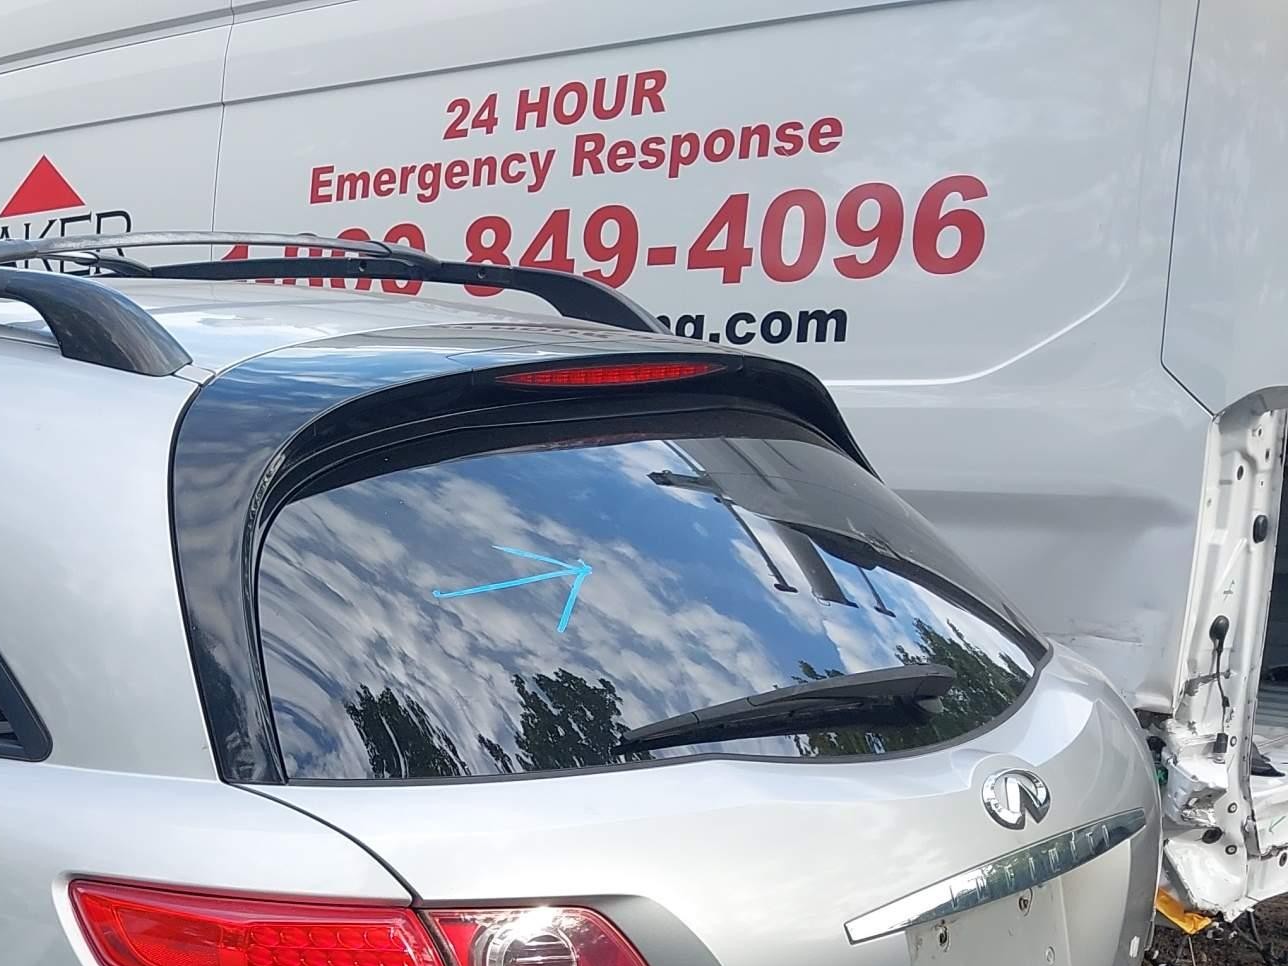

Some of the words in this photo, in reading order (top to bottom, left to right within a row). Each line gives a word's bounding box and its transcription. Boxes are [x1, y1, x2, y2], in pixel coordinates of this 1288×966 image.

[442, 96, 499, 141] 24
[515, 69, 669, 132] HOUR
[309, 149, 556, 206] Emergency
[571, 116, 845, 179] Response
